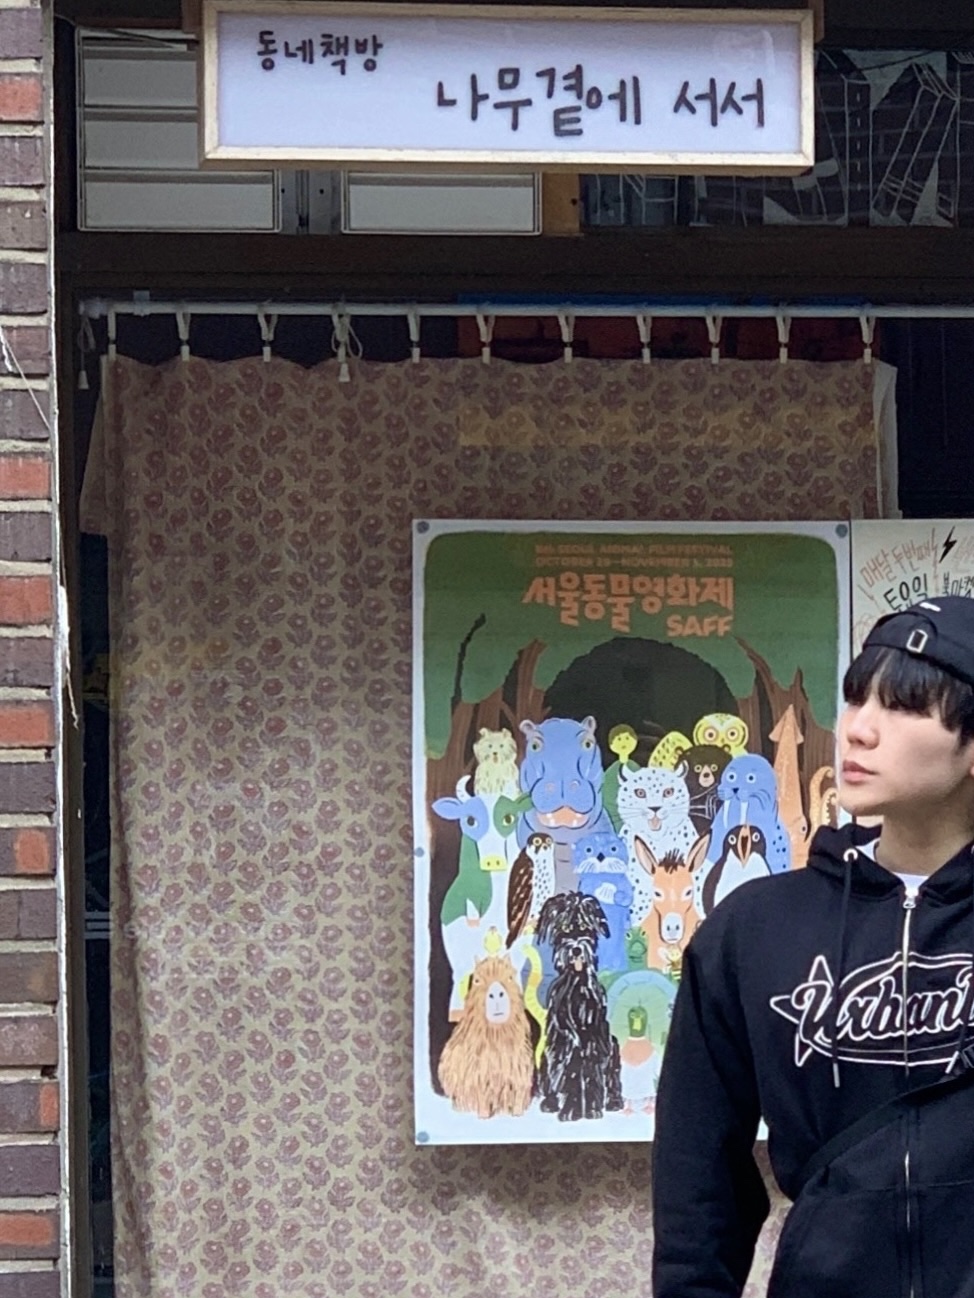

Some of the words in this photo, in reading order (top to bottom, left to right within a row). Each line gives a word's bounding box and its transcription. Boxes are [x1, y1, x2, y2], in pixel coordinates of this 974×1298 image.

[255, 30, 384, 76] 동네책방
[436, 64, 642, 137] 나무곁에
[673, 77, 765, 128] 서서
[522, 571, 734, 633] 서울동물영화제
[666, 614, 734, 637] SAFF
